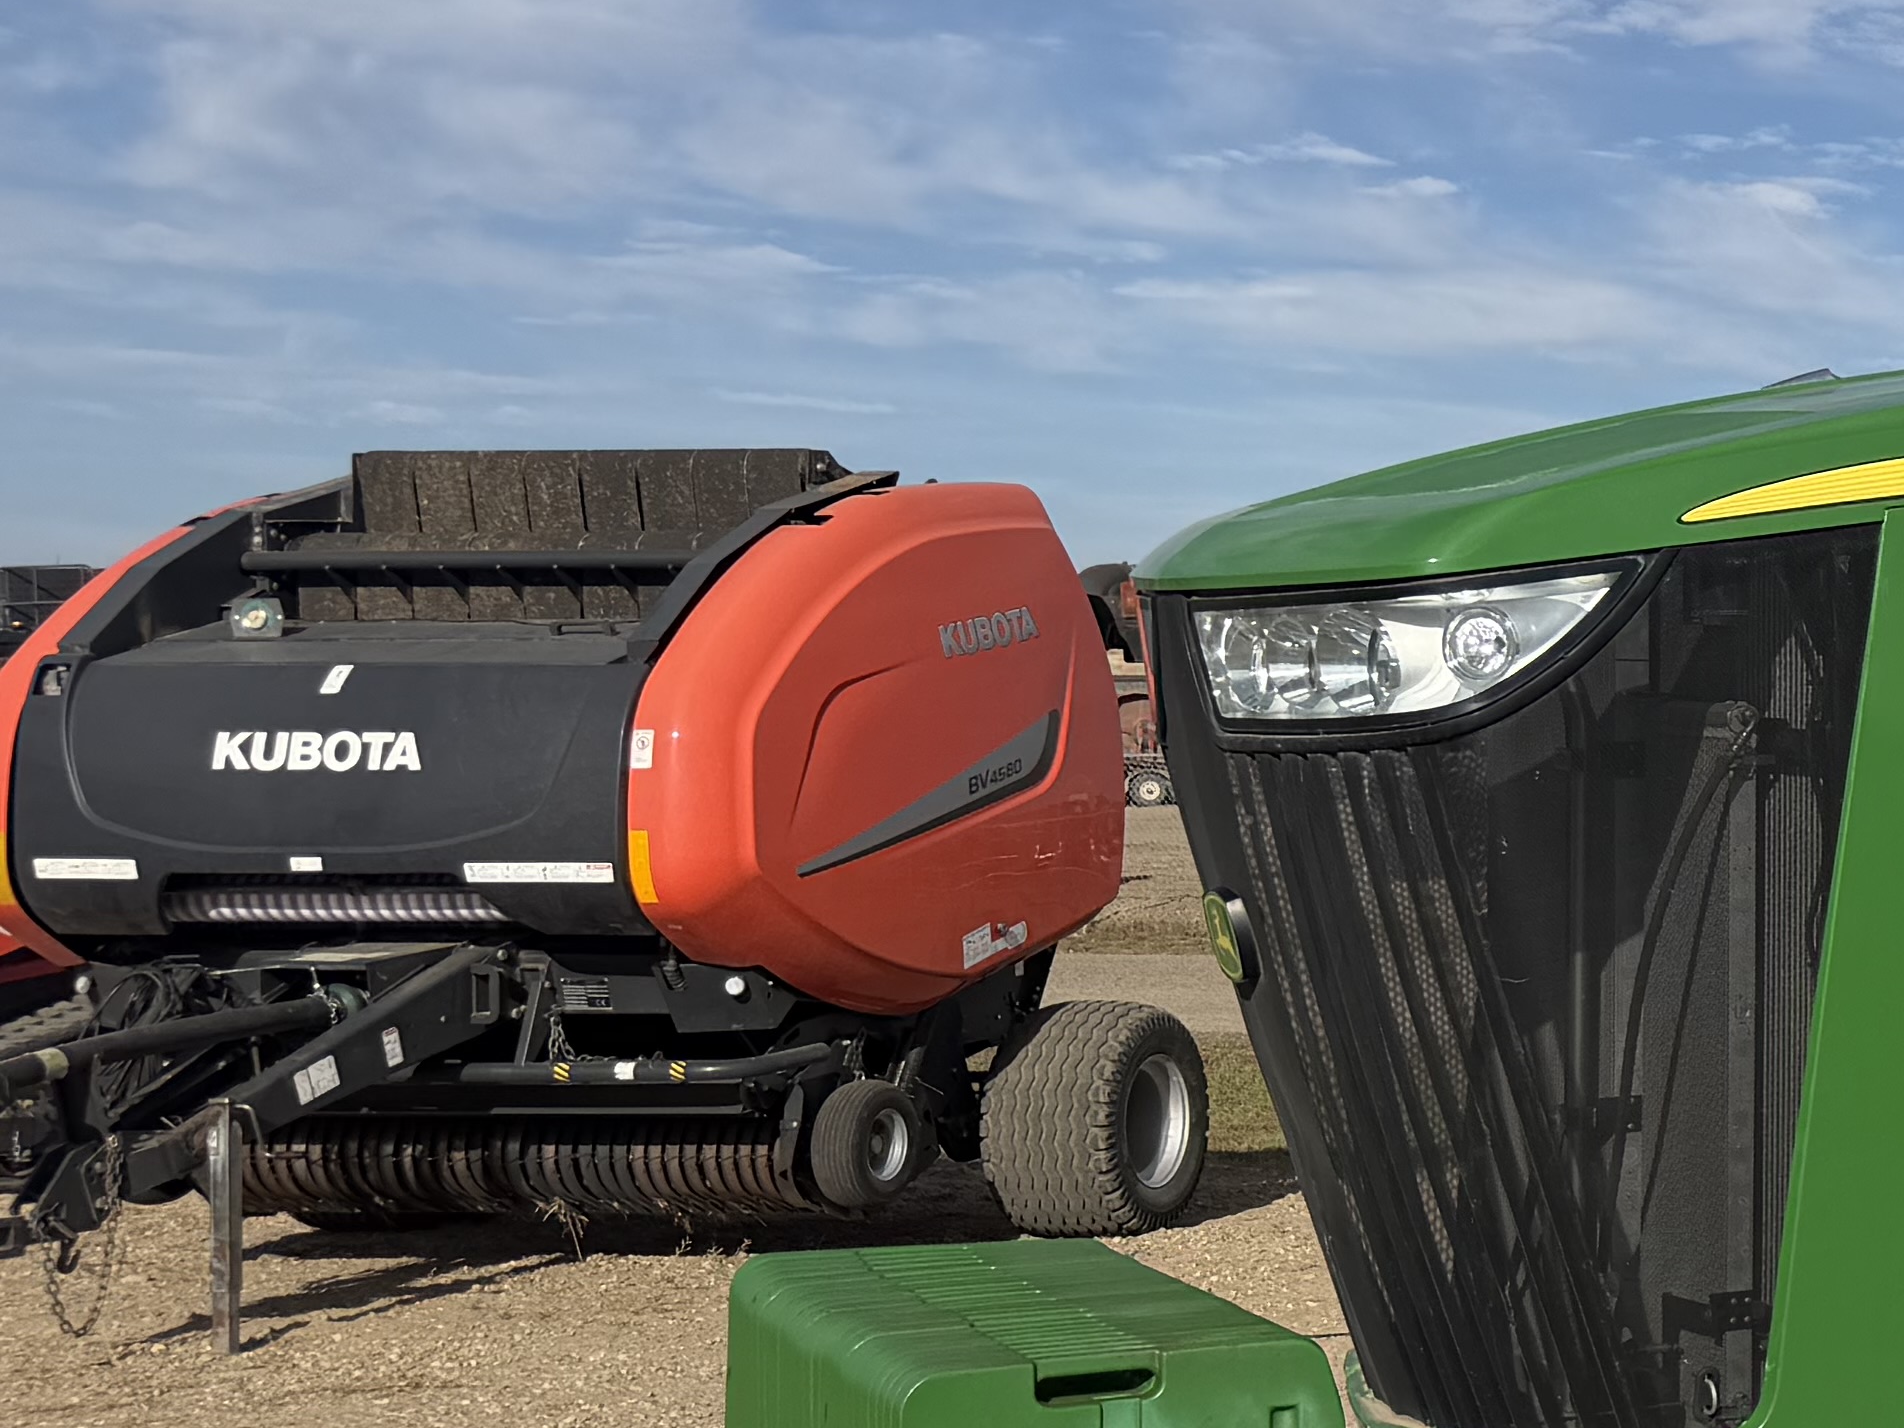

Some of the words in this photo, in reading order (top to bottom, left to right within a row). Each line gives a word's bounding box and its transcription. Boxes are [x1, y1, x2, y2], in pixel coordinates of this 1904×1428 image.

[937, 606, 1040, 659] KUBOTA
[211, 730, 422, 772] KUBOTA
[968, 758, 1022, 795] BV4580
